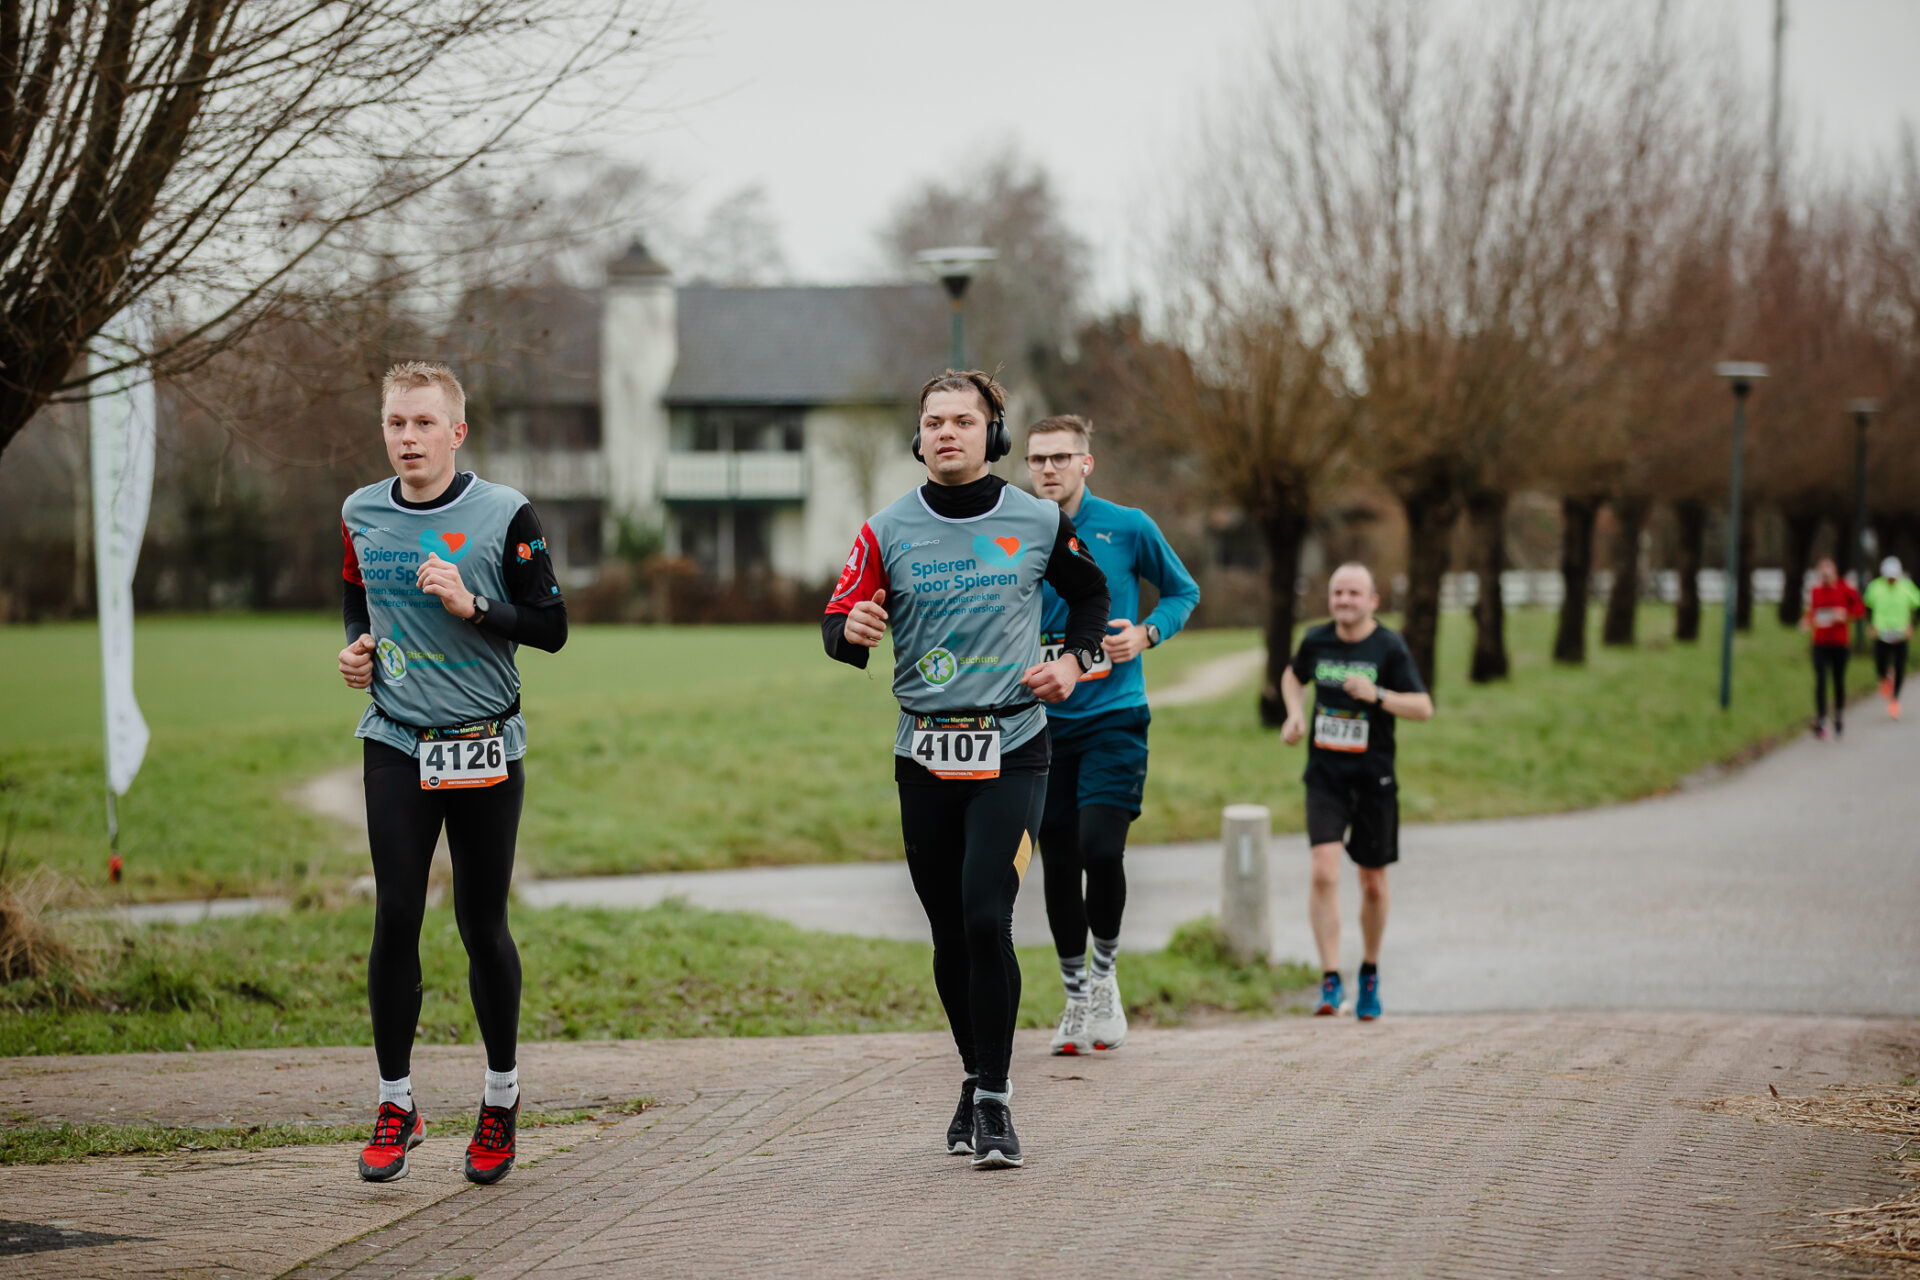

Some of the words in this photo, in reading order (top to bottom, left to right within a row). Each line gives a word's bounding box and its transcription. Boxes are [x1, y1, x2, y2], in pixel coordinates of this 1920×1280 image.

[363, 546, 419, 565] Spieren
[364, 568, 392, 580] voor
[911, 558, 977, 579] Spieren
[912, 578, 950, 594] voor
[954, 572, 1018, 592] Spieren
[947, 592, 1001, 605] spierziekten
[959, 655, 1000, 665] Stichting
[460, 724, 485, 734] Marathon
[425, 740, 502, 771] 4126
[916, 733, 993, 762] 4107
